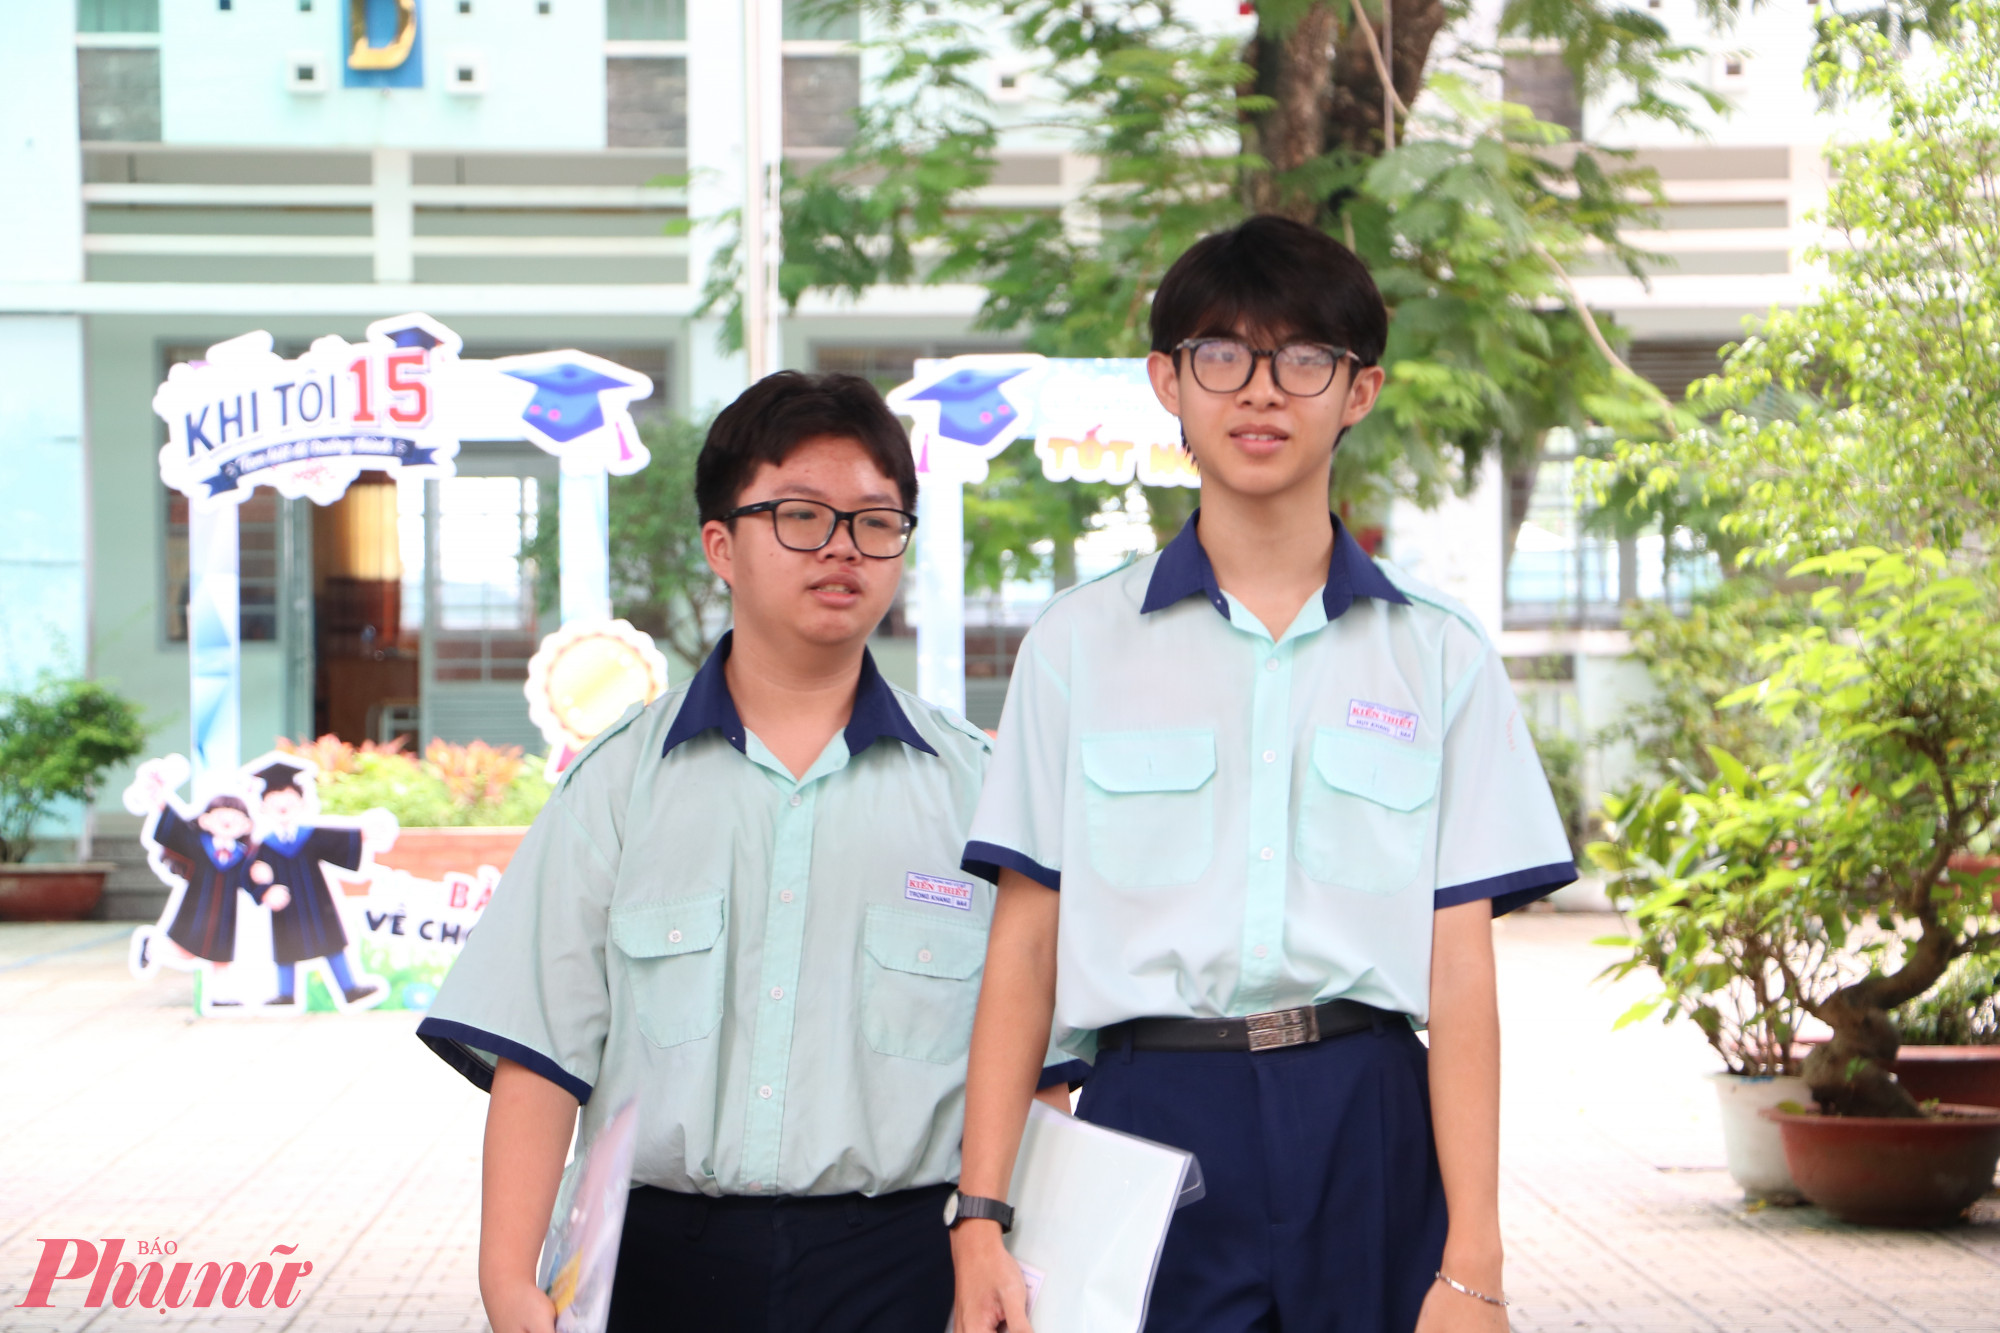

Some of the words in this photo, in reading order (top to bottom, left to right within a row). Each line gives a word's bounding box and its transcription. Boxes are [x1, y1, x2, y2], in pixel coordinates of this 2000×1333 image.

[184, 390, 259, 458] KHI
[273, 368, 336, 427] TÔI
[349, 353, 428, 423] 15
[418, 919, 475, 945] CH
